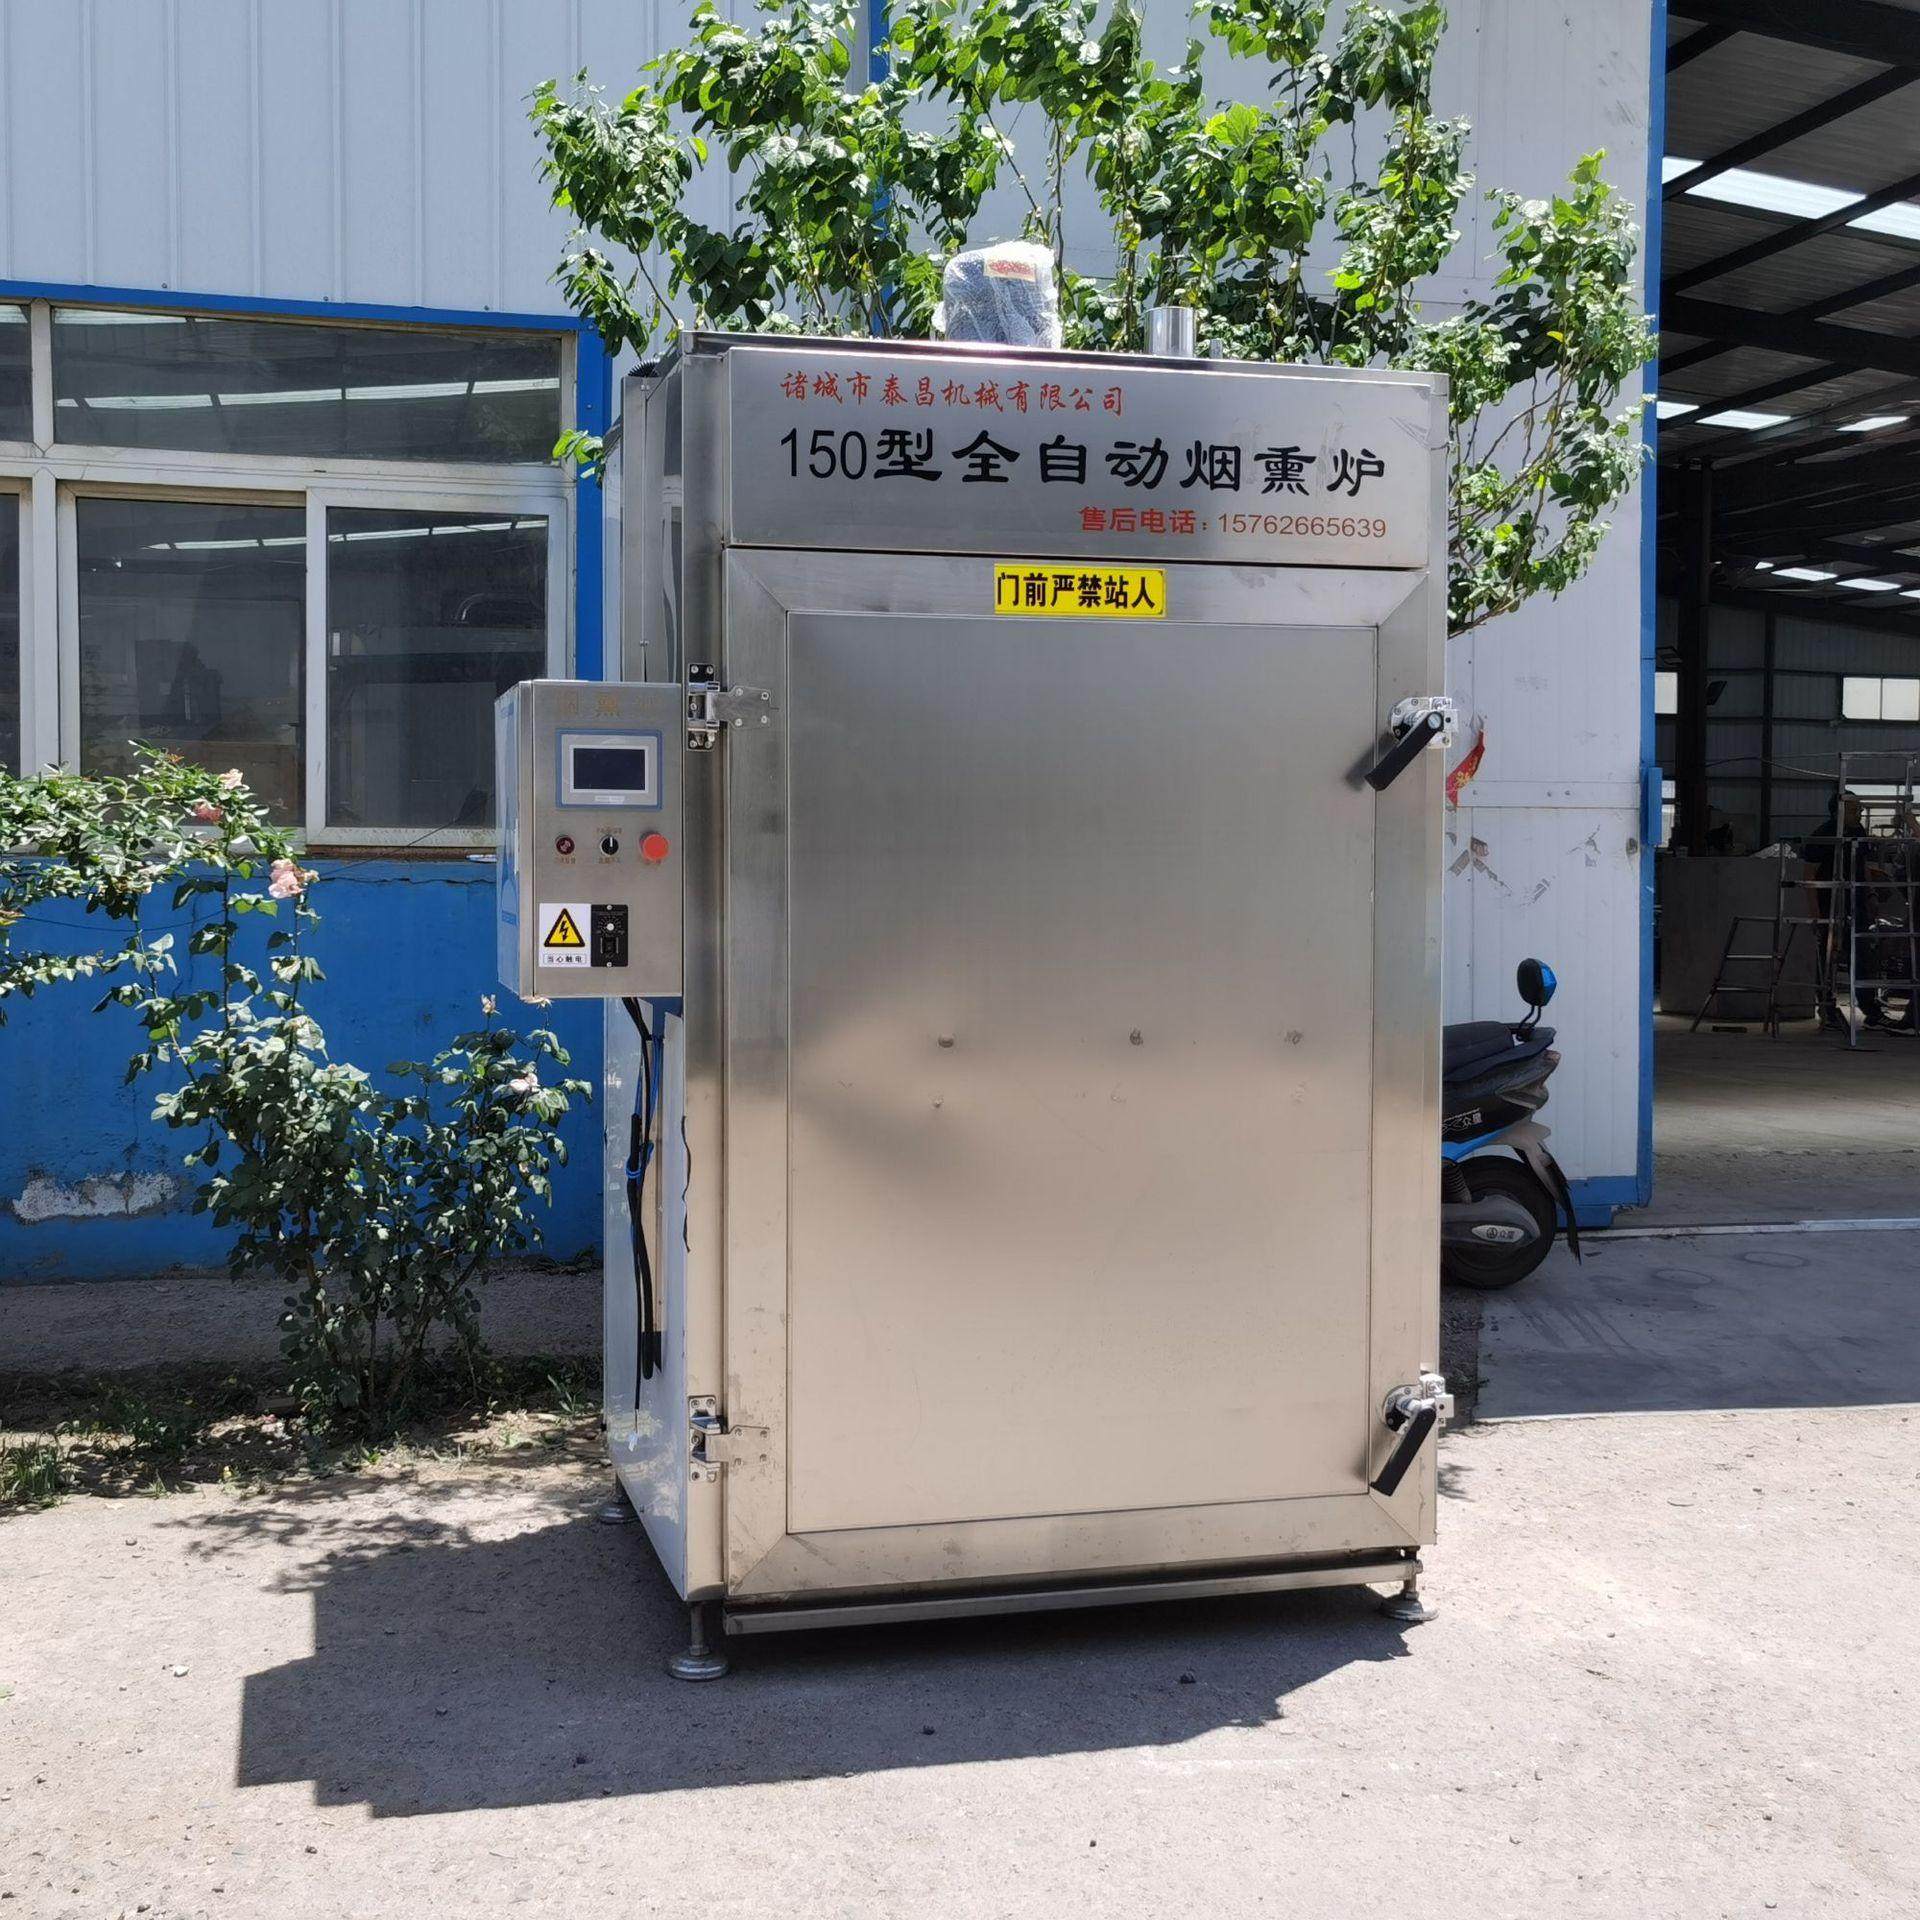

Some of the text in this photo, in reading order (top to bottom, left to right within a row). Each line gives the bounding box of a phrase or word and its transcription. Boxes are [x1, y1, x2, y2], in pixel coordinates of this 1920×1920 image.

[780, 371, 1124, 417] 诸城市泰昌机械有限公司
[780, 427, 1386, 497] 150型全自动烟熏炉
[997, 572, 1156, 609] 门前严禁站人
